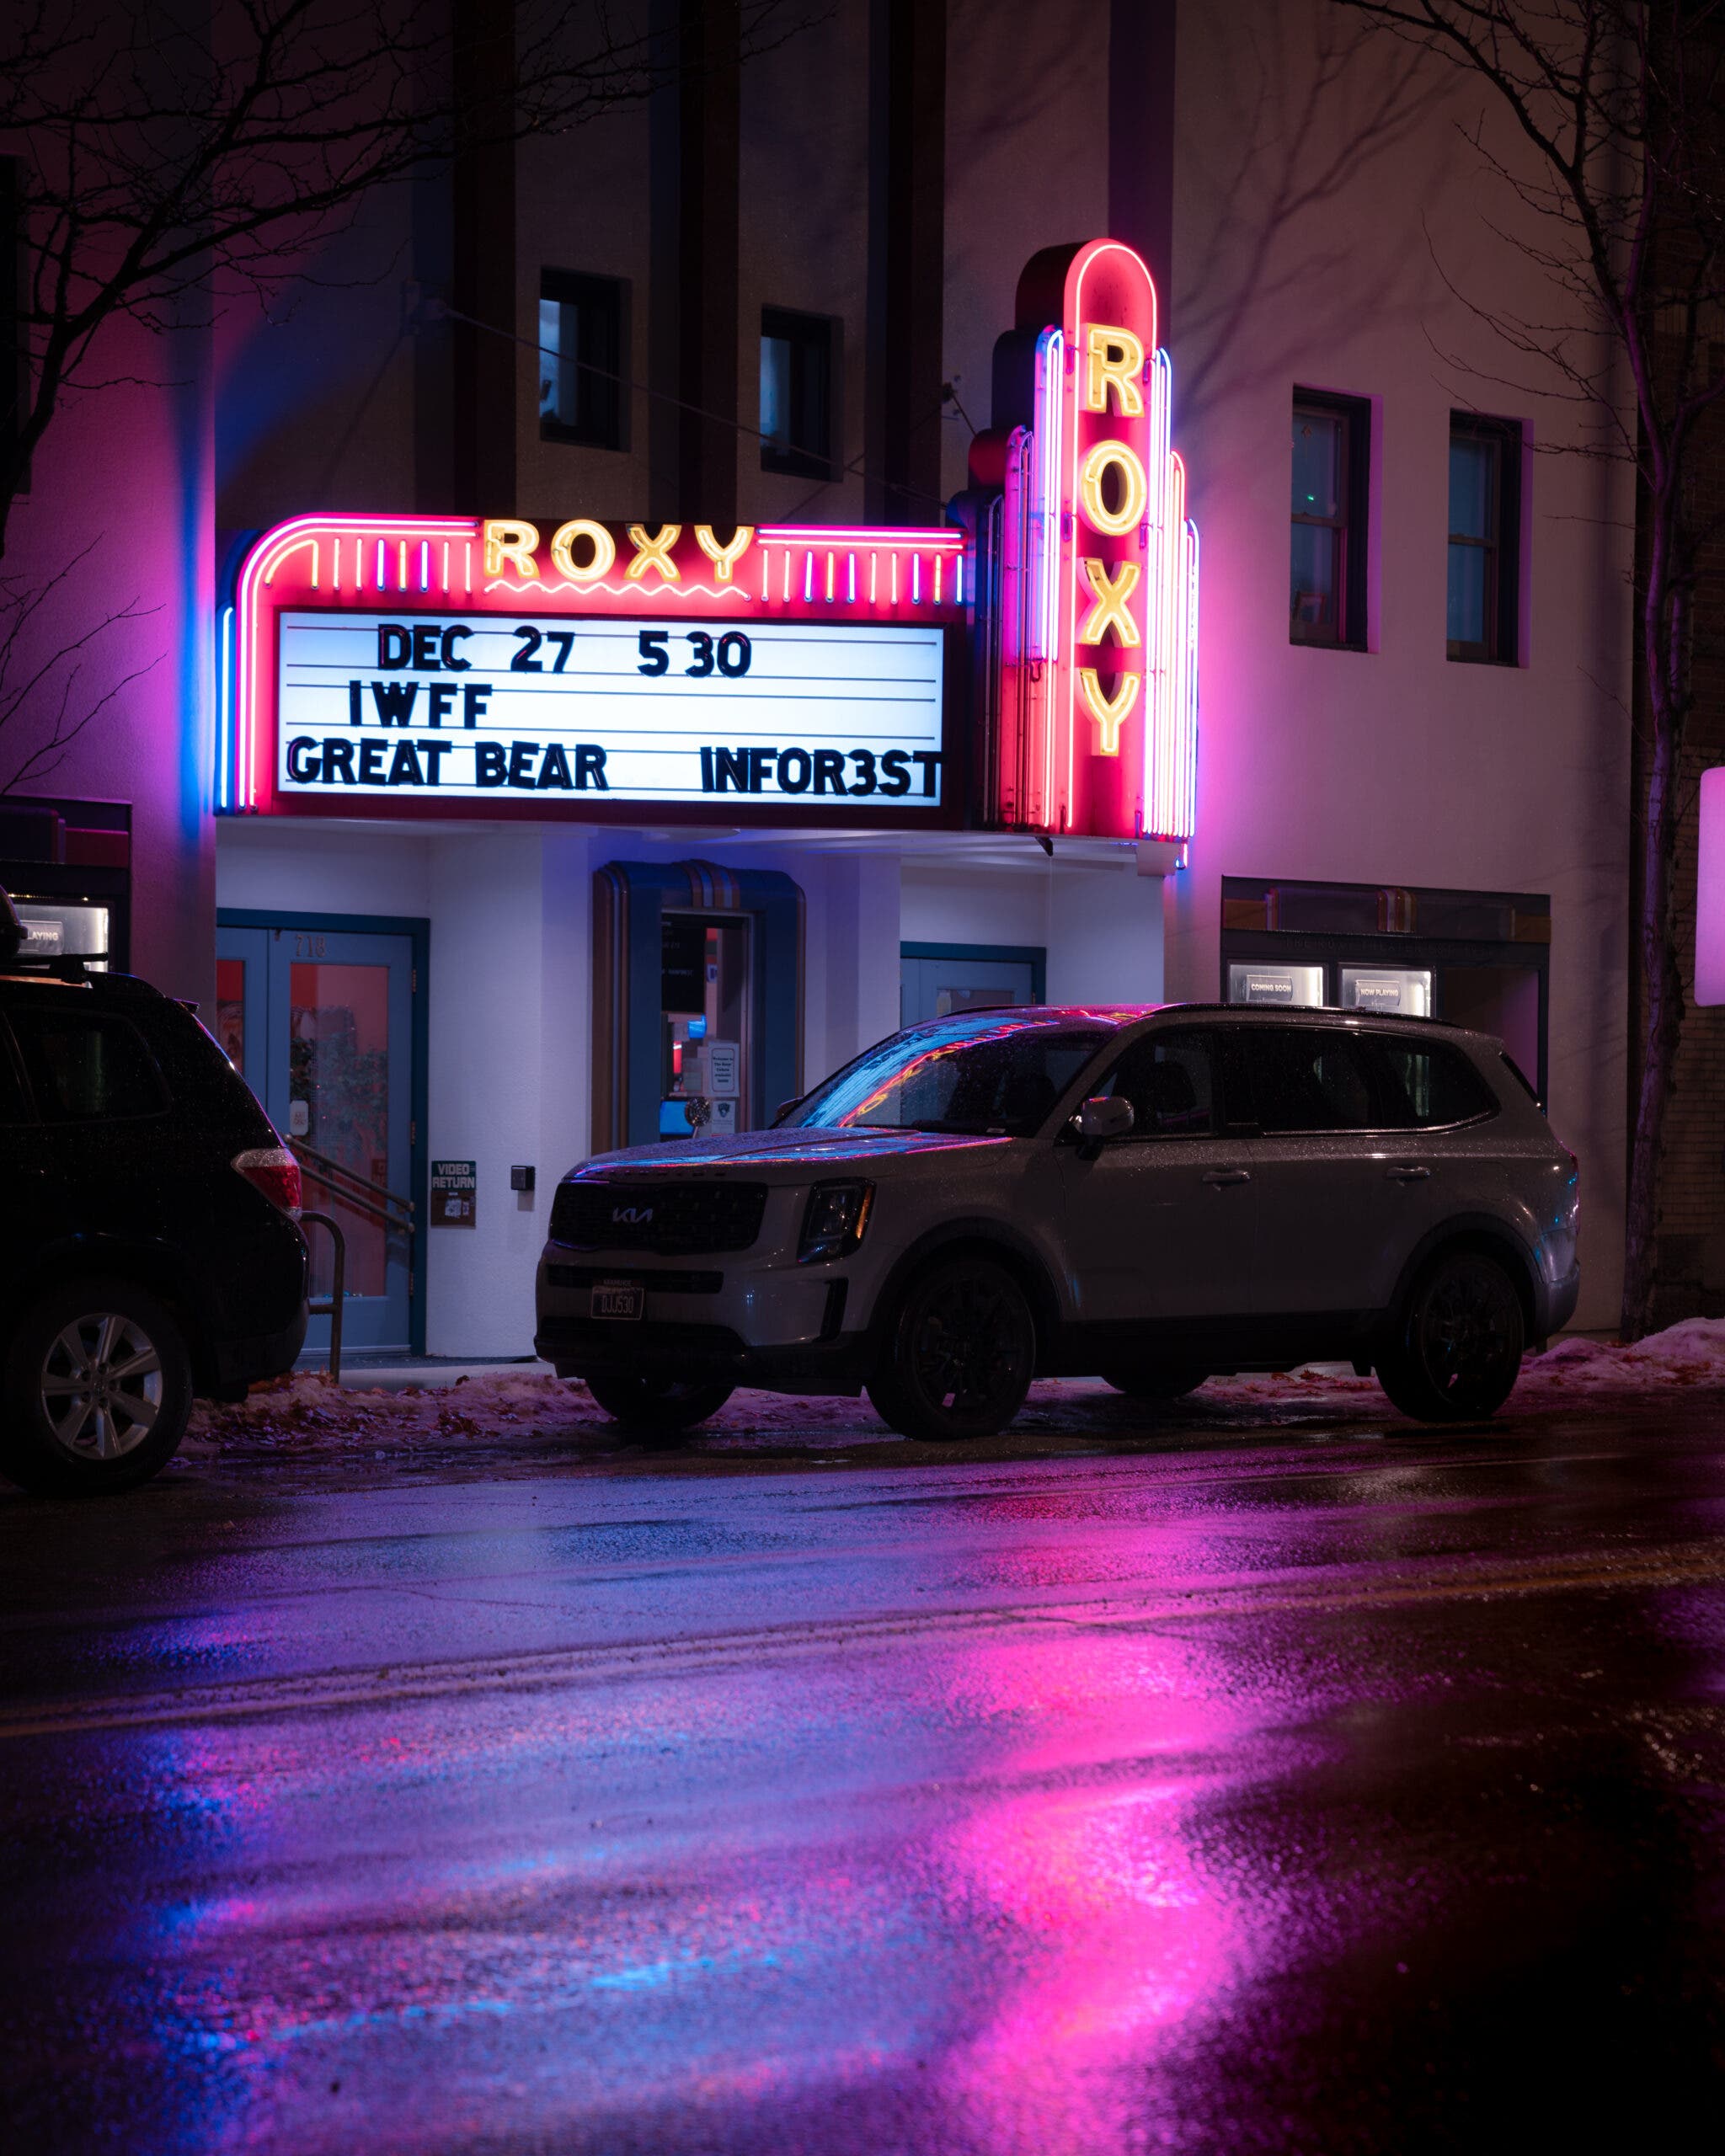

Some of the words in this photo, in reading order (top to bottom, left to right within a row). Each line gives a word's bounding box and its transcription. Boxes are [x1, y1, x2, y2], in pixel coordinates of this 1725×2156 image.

[1077, 322, 1147, 757] ROXY
[483, 519, 755, 583] ROXY
[377, 623, 473, 672] DEC
[510, 626, 574, 673] 27
[349, 680, 492, 729] IWFF
[287, 737, 451, 787] GREAT
[475, 741, 606, 791] BEAR
[700, 746, 947, 798] INFOR3ST
[27, 931, 60, 942] LAYING
[296, 934, 326, 958] 718
[1251, 983, 1274, 992] COMING
[1275, 984, 1292, 993] SOON
[1360, 988, 1375, 996] NOW
[1375, 989, 1400, 997] PLAYING
[437, 1163, 470, 1176] VIDEO
[432, 1177, 475, 1188] RETURN
[612, 1206, 654, 1224] KIA
